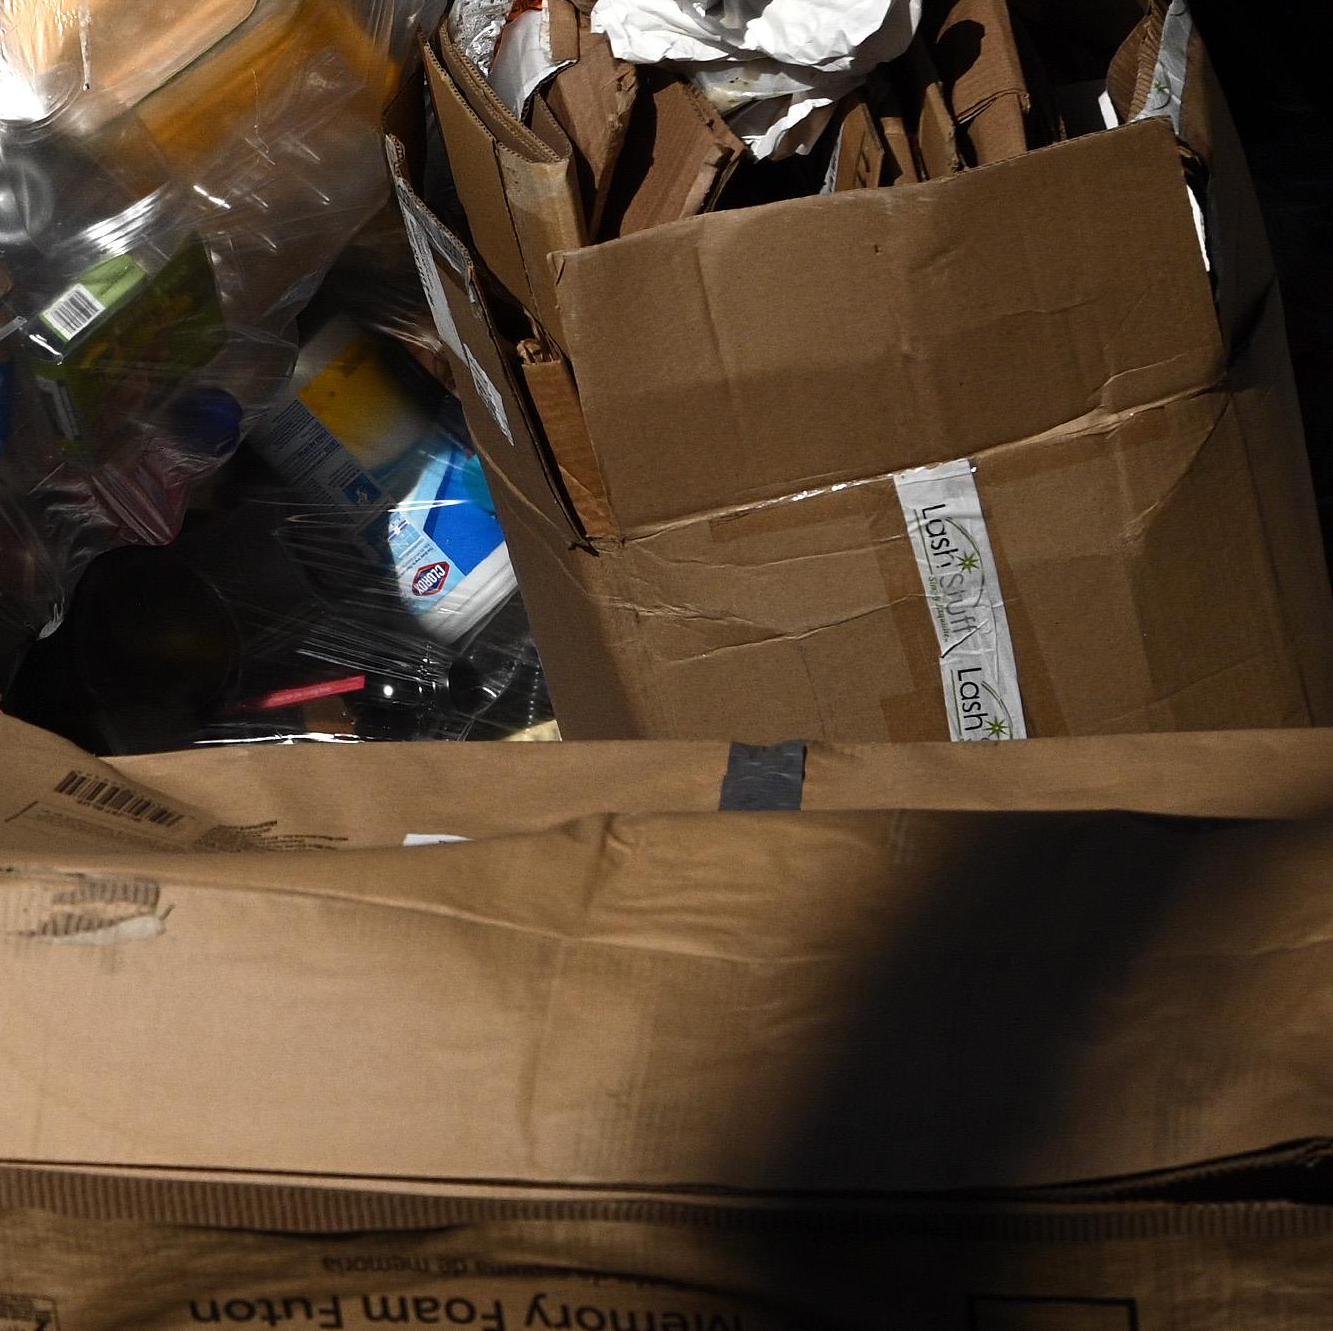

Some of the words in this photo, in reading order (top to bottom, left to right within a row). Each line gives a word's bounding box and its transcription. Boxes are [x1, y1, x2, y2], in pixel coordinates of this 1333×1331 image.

[413, 563, 447, 595] CLOROX
[940, 572, 977, 633] Stuff
[957, 666, 989, 731] Lash
[188, 1293, 342, 1330] Futon
[362, 1293, 507, 1331] Foam
[524, 1292, 743, 1331] Memory
